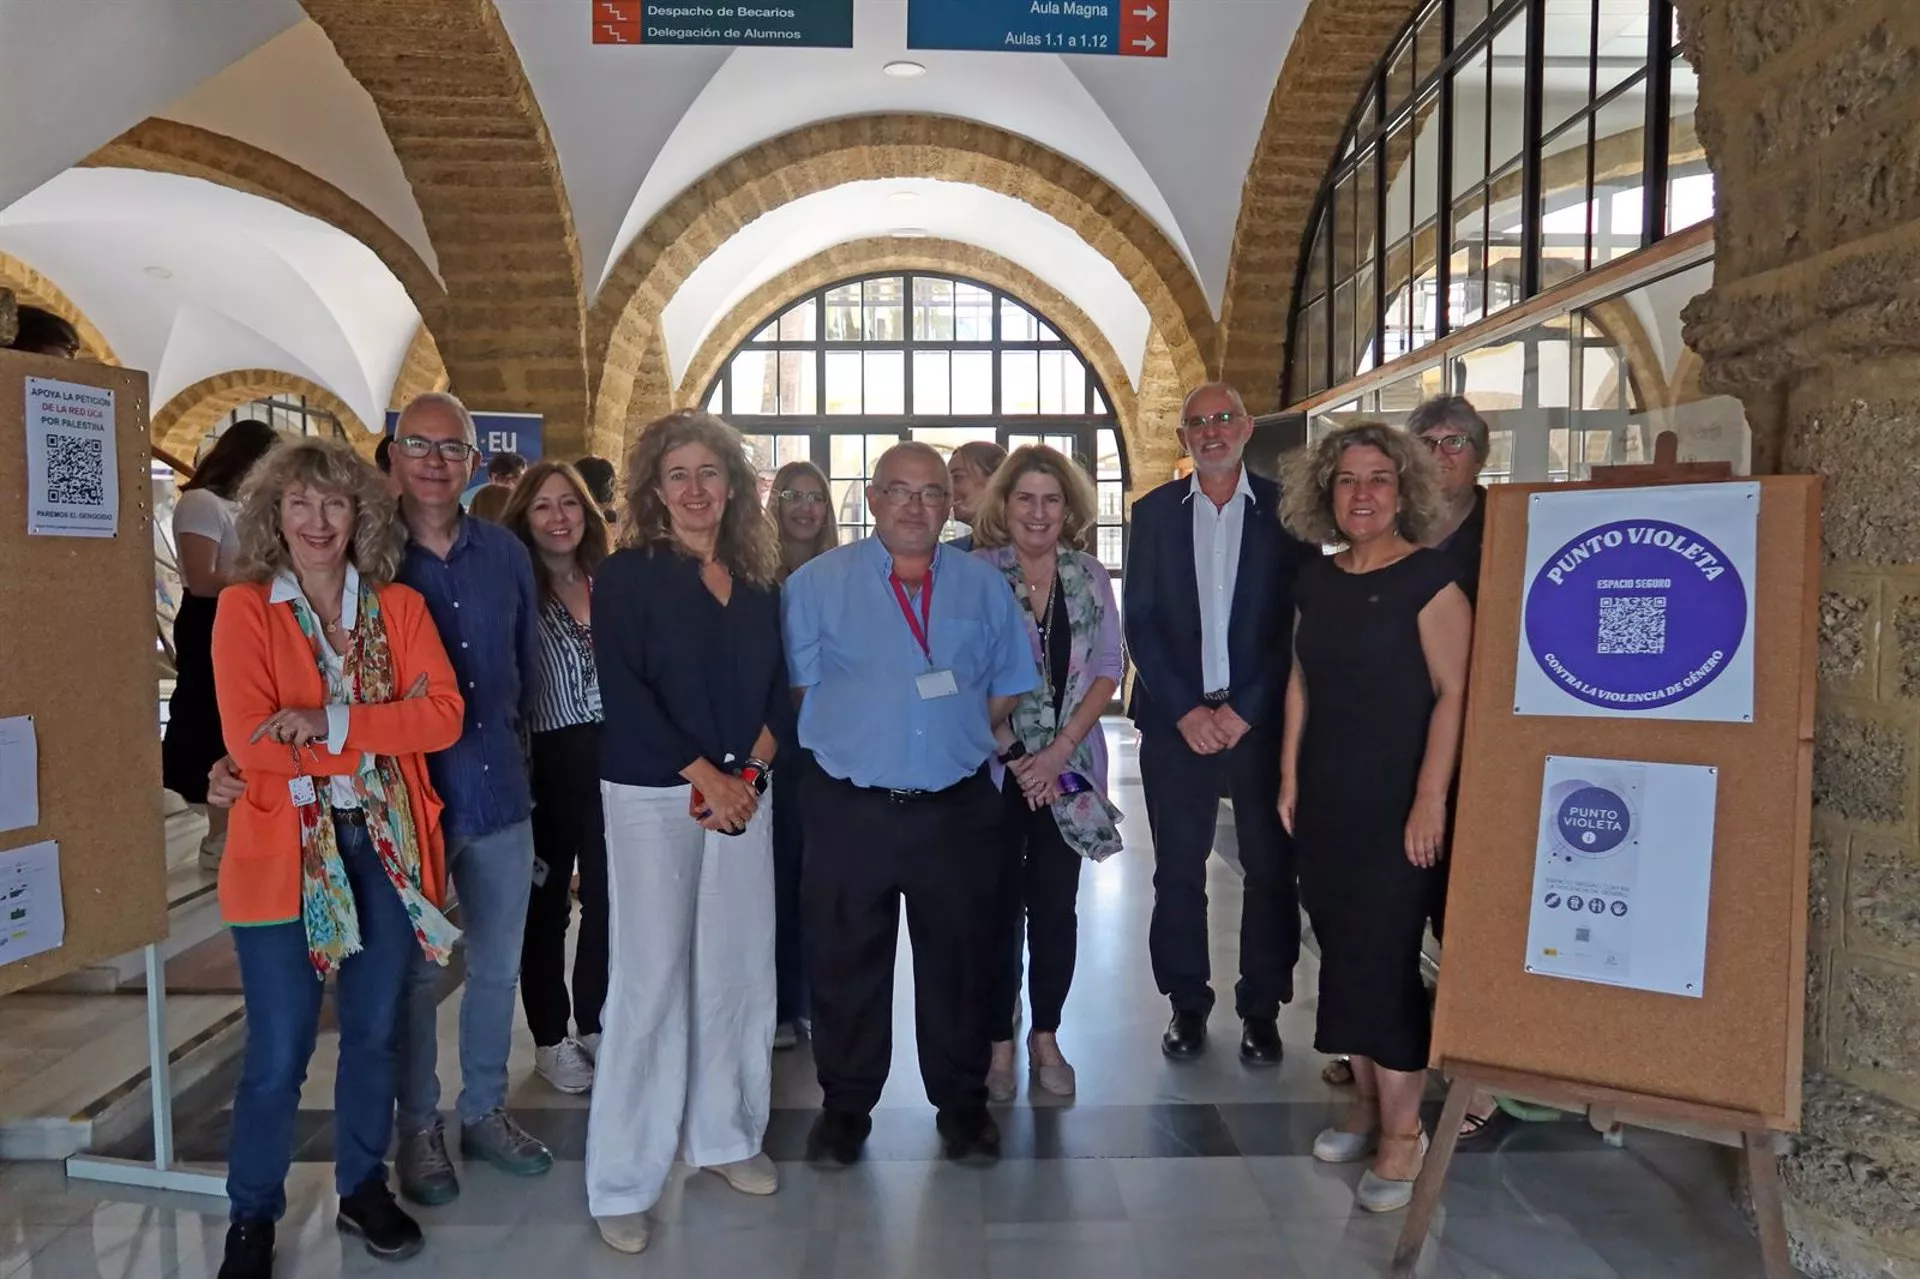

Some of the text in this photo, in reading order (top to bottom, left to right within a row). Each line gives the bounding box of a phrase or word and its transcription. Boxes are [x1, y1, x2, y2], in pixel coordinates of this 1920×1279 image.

[648, 5, 795, 18] Despacho de Becarios
[1030, 1, 1108, 19] Aula Magna
[648, 27, 801, 39] Delegación de Alumnos
[1005, 31, 1108, 48] Aulas 1.1 a 1.12
[31, 388, 61, 399] APOYA
[63, 392, 74, 401] LA
[42, 403, 54, 412] DE
[56, 406, 67, 414] LA
[68, 406, 86, 416] RED
[41, 415, 105, 432] POR PALESTINA
[488, 431, 517, 453] EU
[36, 510, 68, 518] PAREMOS
[69, 511, 77, 519] EL
[1547, 527, 1725, 586] PUNTO VIOLETA
[1597, 578, 1671, 589] ESPACIO SEGURO
[1544, 650, 1723, 703] CONTRA LA VIOLENCIA DE GÉNERO
[1569, 806, 1618, 820] PUNTO
[1563, 817, 1622, 831] VIOLETA
